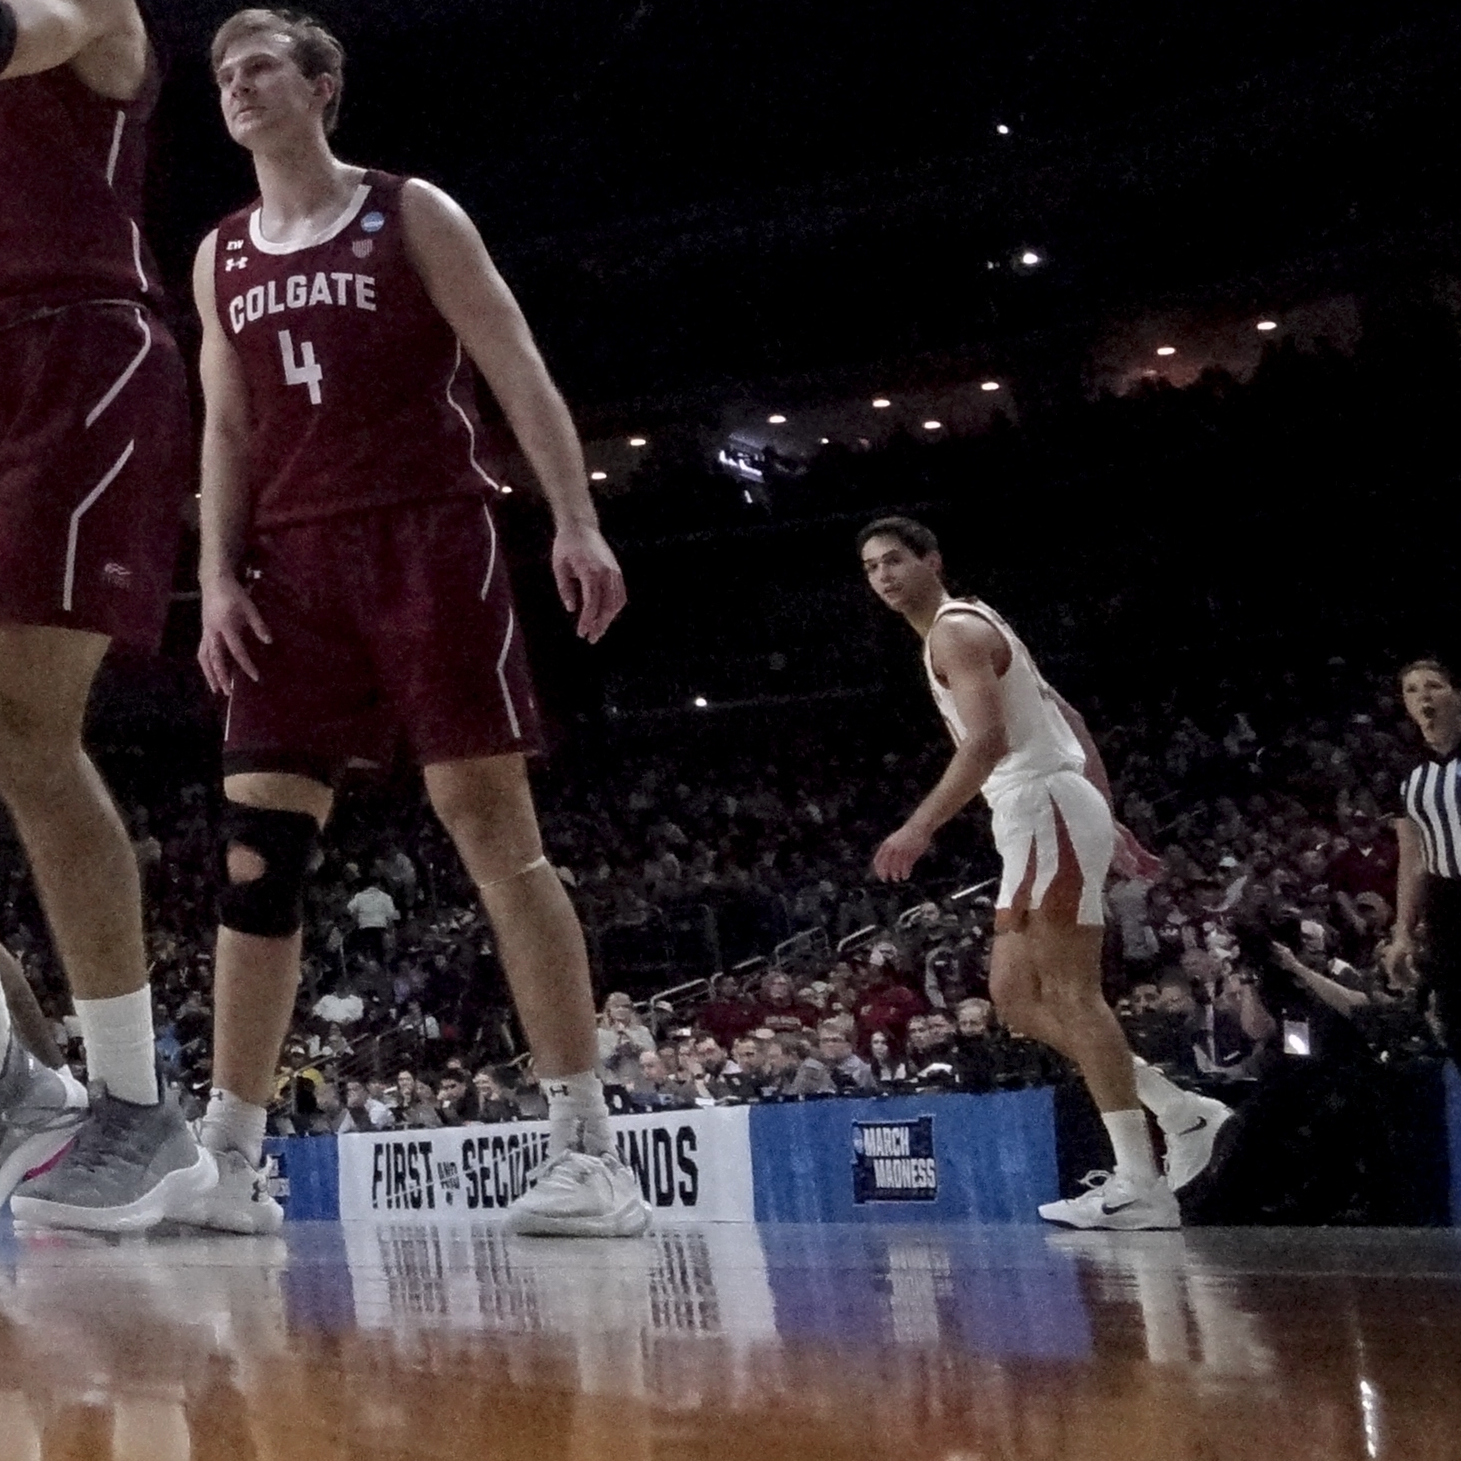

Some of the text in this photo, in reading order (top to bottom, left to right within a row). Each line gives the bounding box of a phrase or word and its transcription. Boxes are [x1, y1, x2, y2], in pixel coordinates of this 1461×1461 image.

[229, 272, 377, 335] COLGATE
[278, 329, 323, 406] 4
[863, 1126, 910, 1157] MARCH
[873, 1157, 936, 1188] MADNESS
[372, 1141, 436, 1210] FIRST
